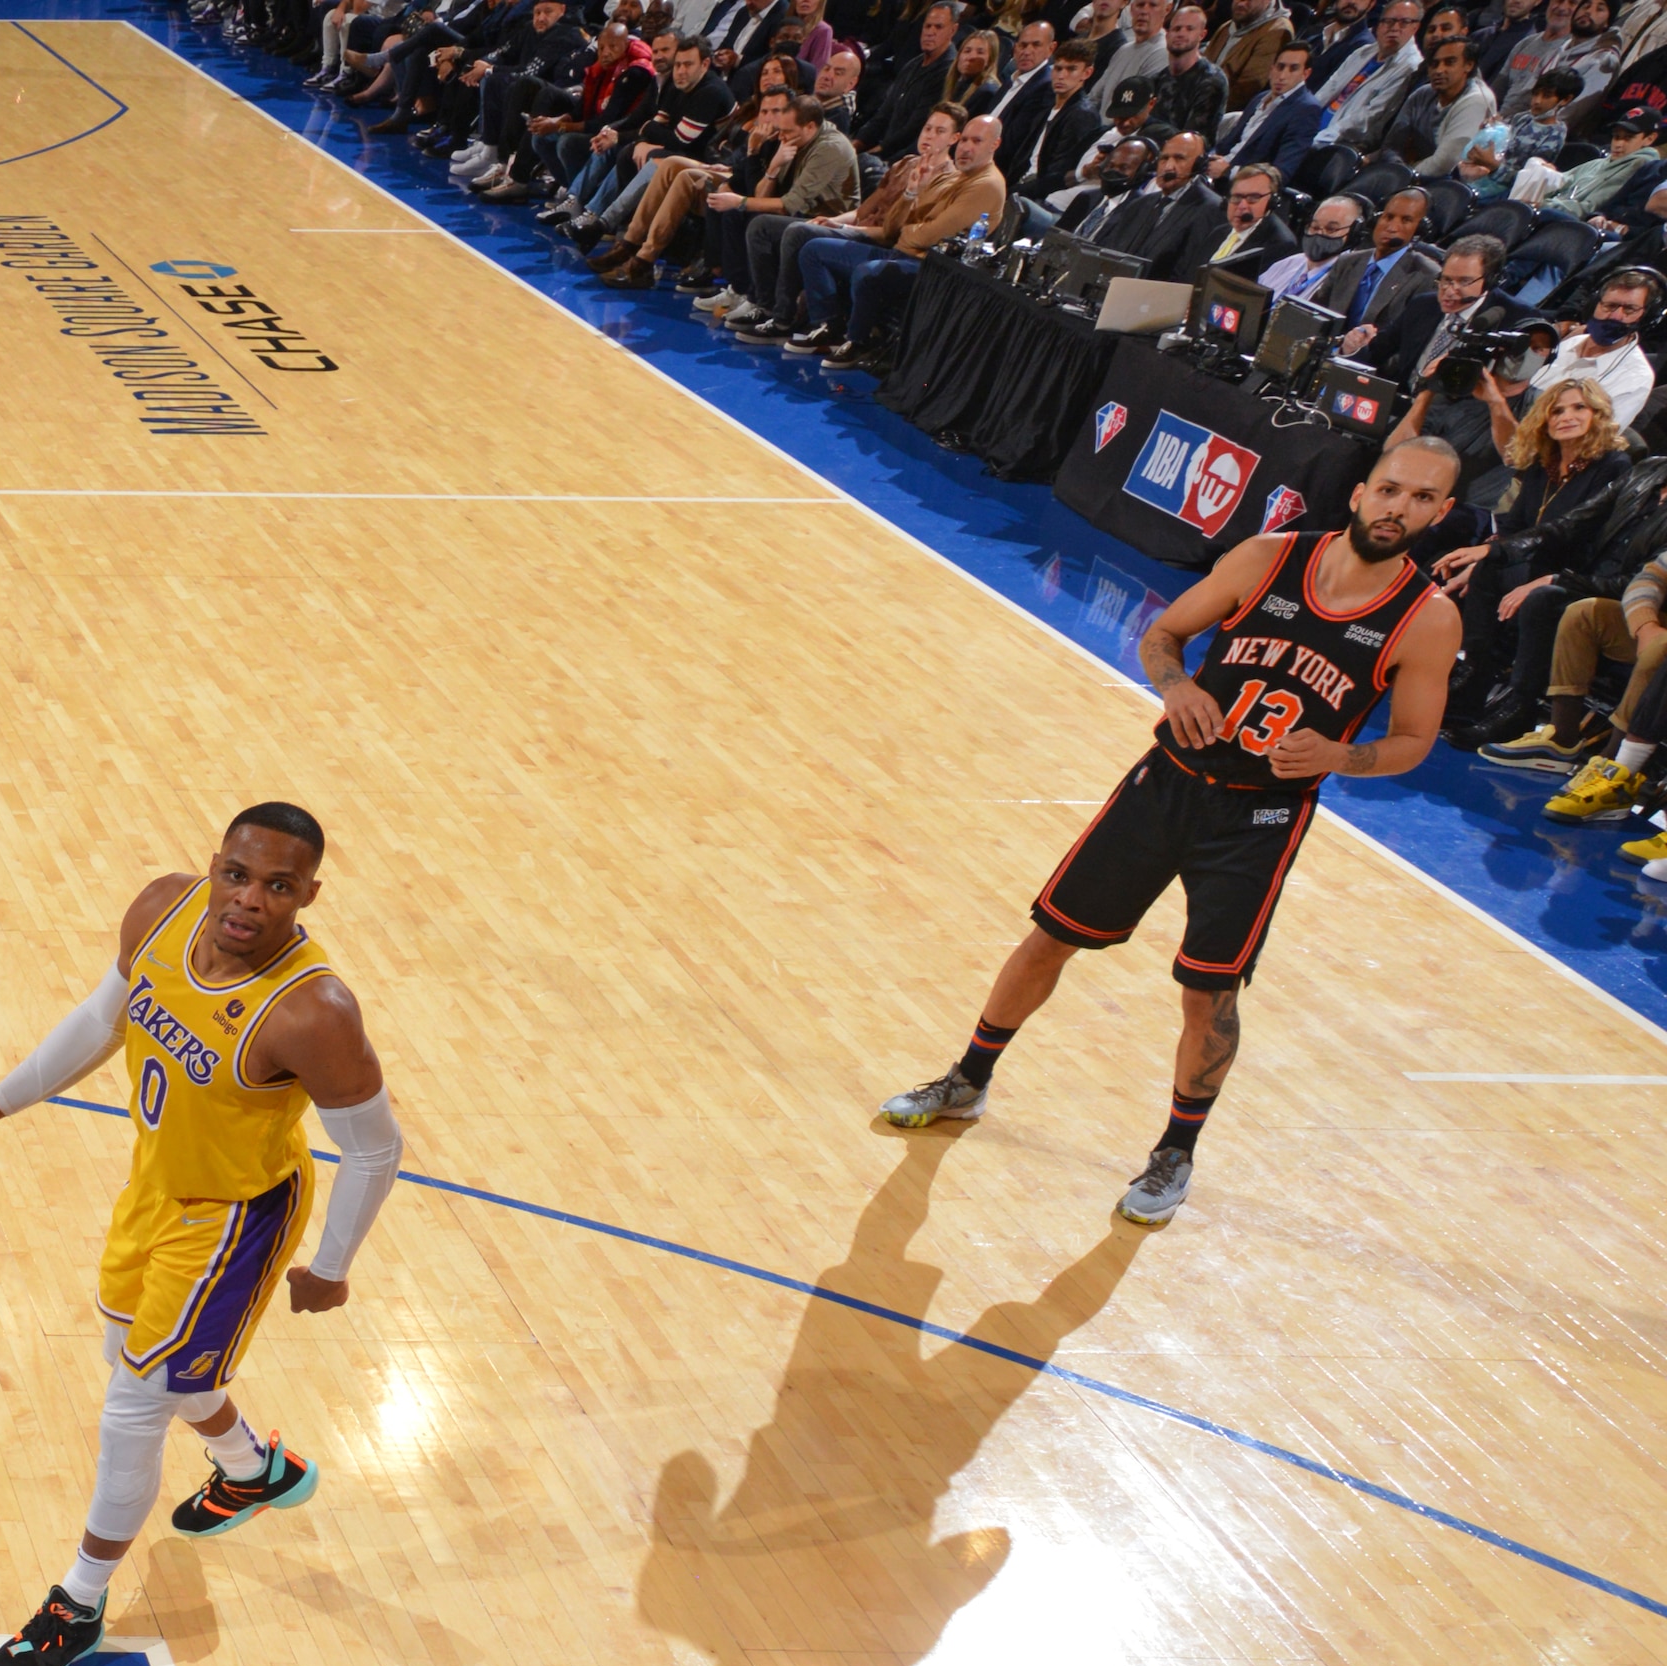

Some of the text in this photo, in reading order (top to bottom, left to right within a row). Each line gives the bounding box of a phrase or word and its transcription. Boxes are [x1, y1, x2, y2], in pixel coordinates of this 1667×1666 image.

[25, 274, 169, 338] SQUARE
[178, 284, 340, 372] CHASE
[89, 344, 269, 435] MADISON
[1140, 431, 1190, 490] NBA
[1344, 630, 1375, 647] SPACE
[1348, 623, 1386, 642] SQUARE
[1221, 636, 1356, 711] NEW YORK
[1215, 678, 1305, 757] 13
[128, 973, 223, 1087] LAKERS
[212, 1009, 239, 1036] bibigo
[139, 1056, 170, 1132] 0
